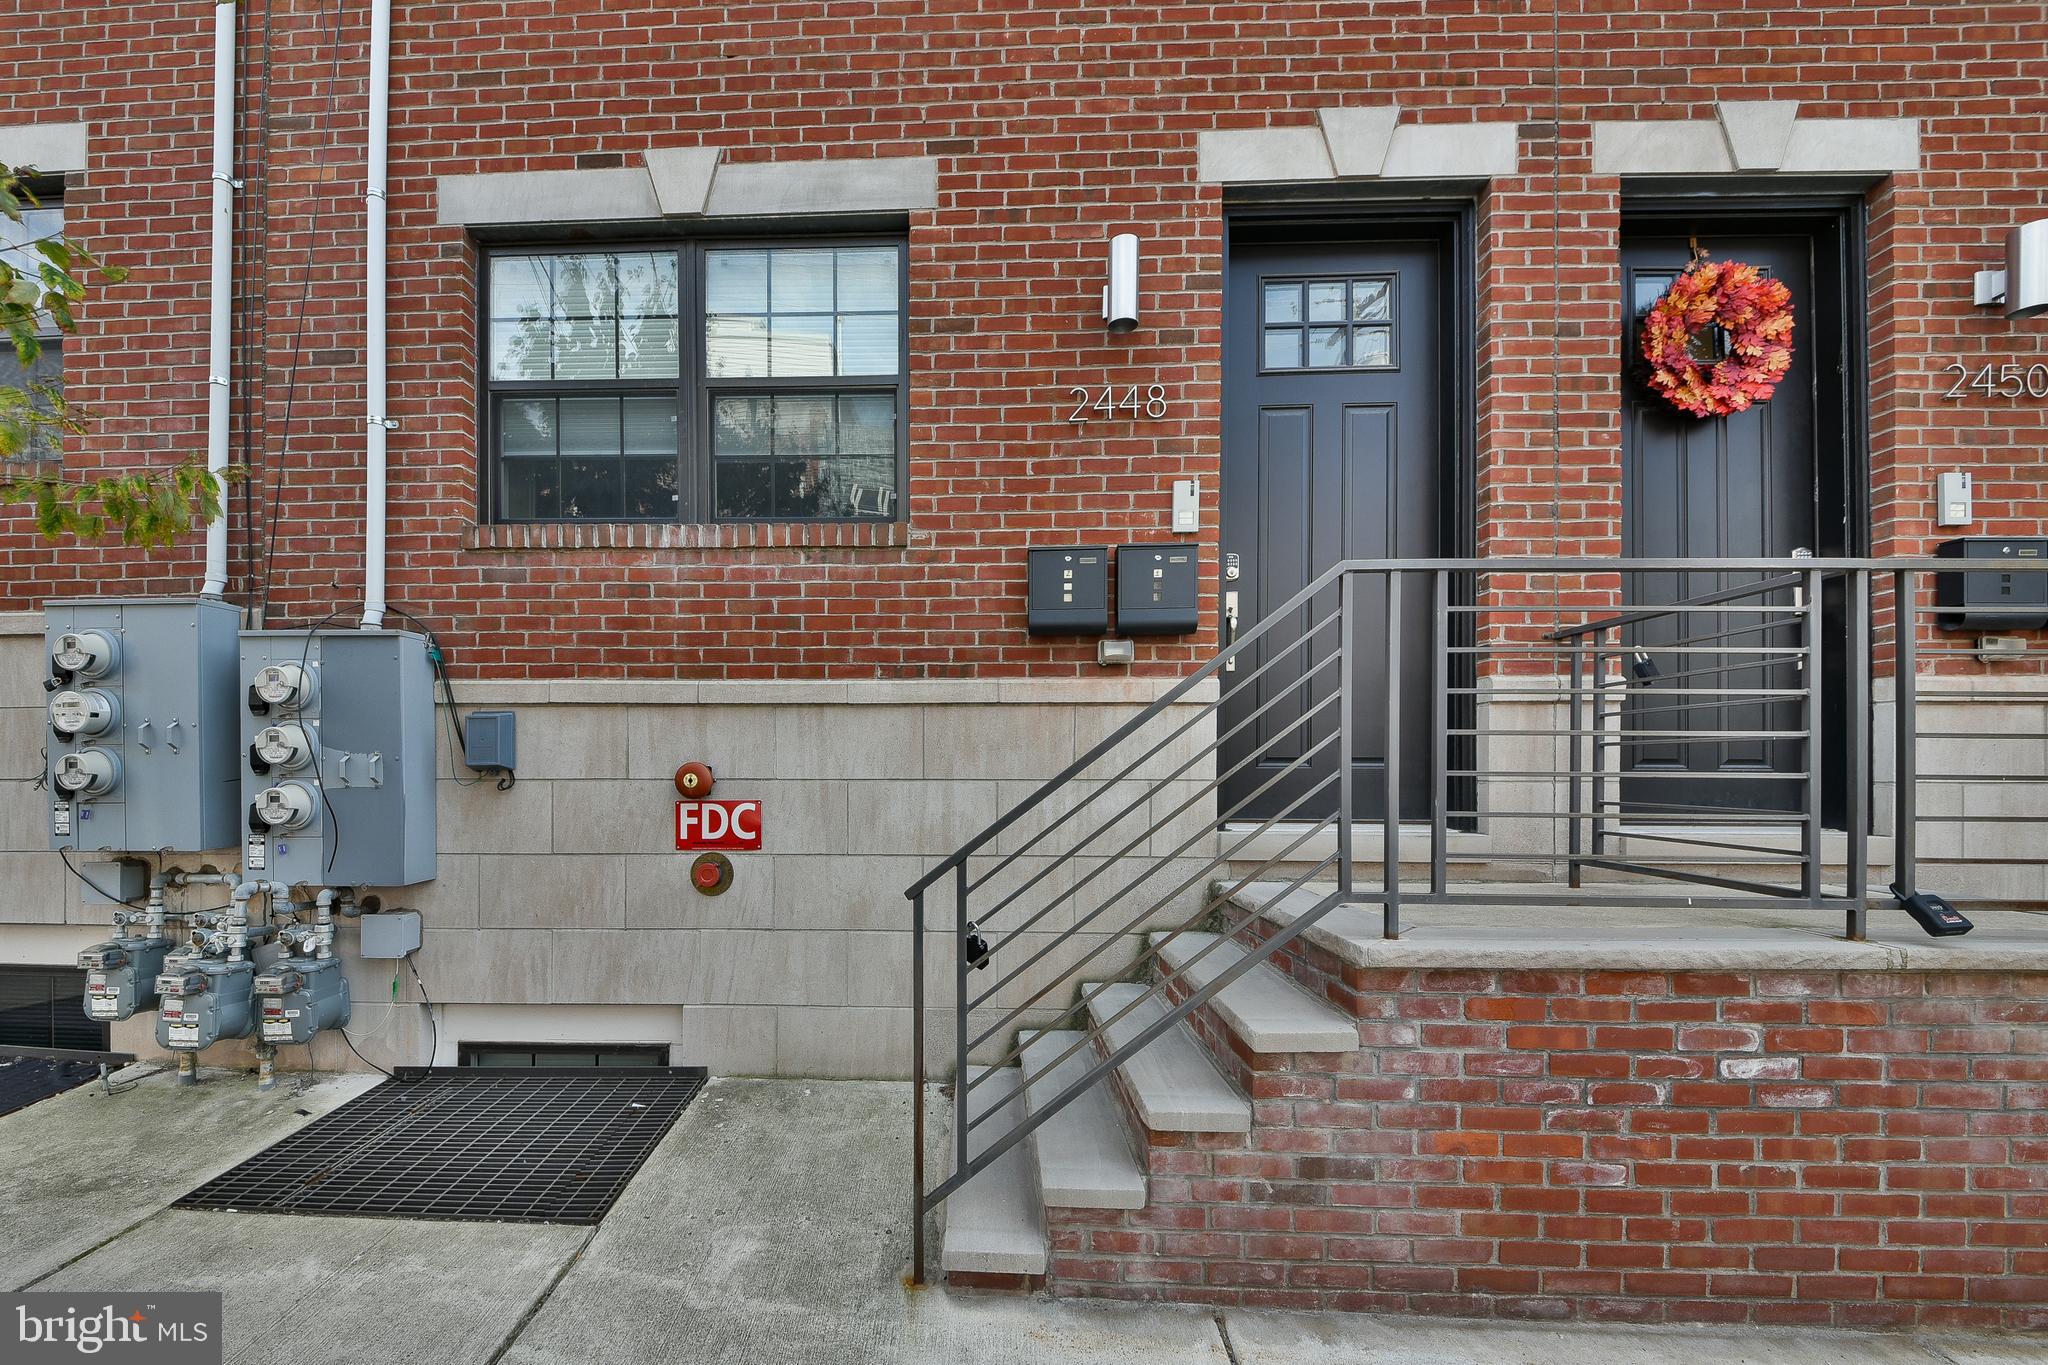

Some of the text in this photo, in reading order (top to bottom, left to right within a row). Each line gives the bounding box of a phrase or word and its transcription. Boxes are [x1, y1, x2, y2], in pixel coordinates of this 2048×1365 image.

[1944, 363, 2048, 398] 2450
[1069, 384, 1167, 421] 2448
[679, 802, 756, 840] FDC
